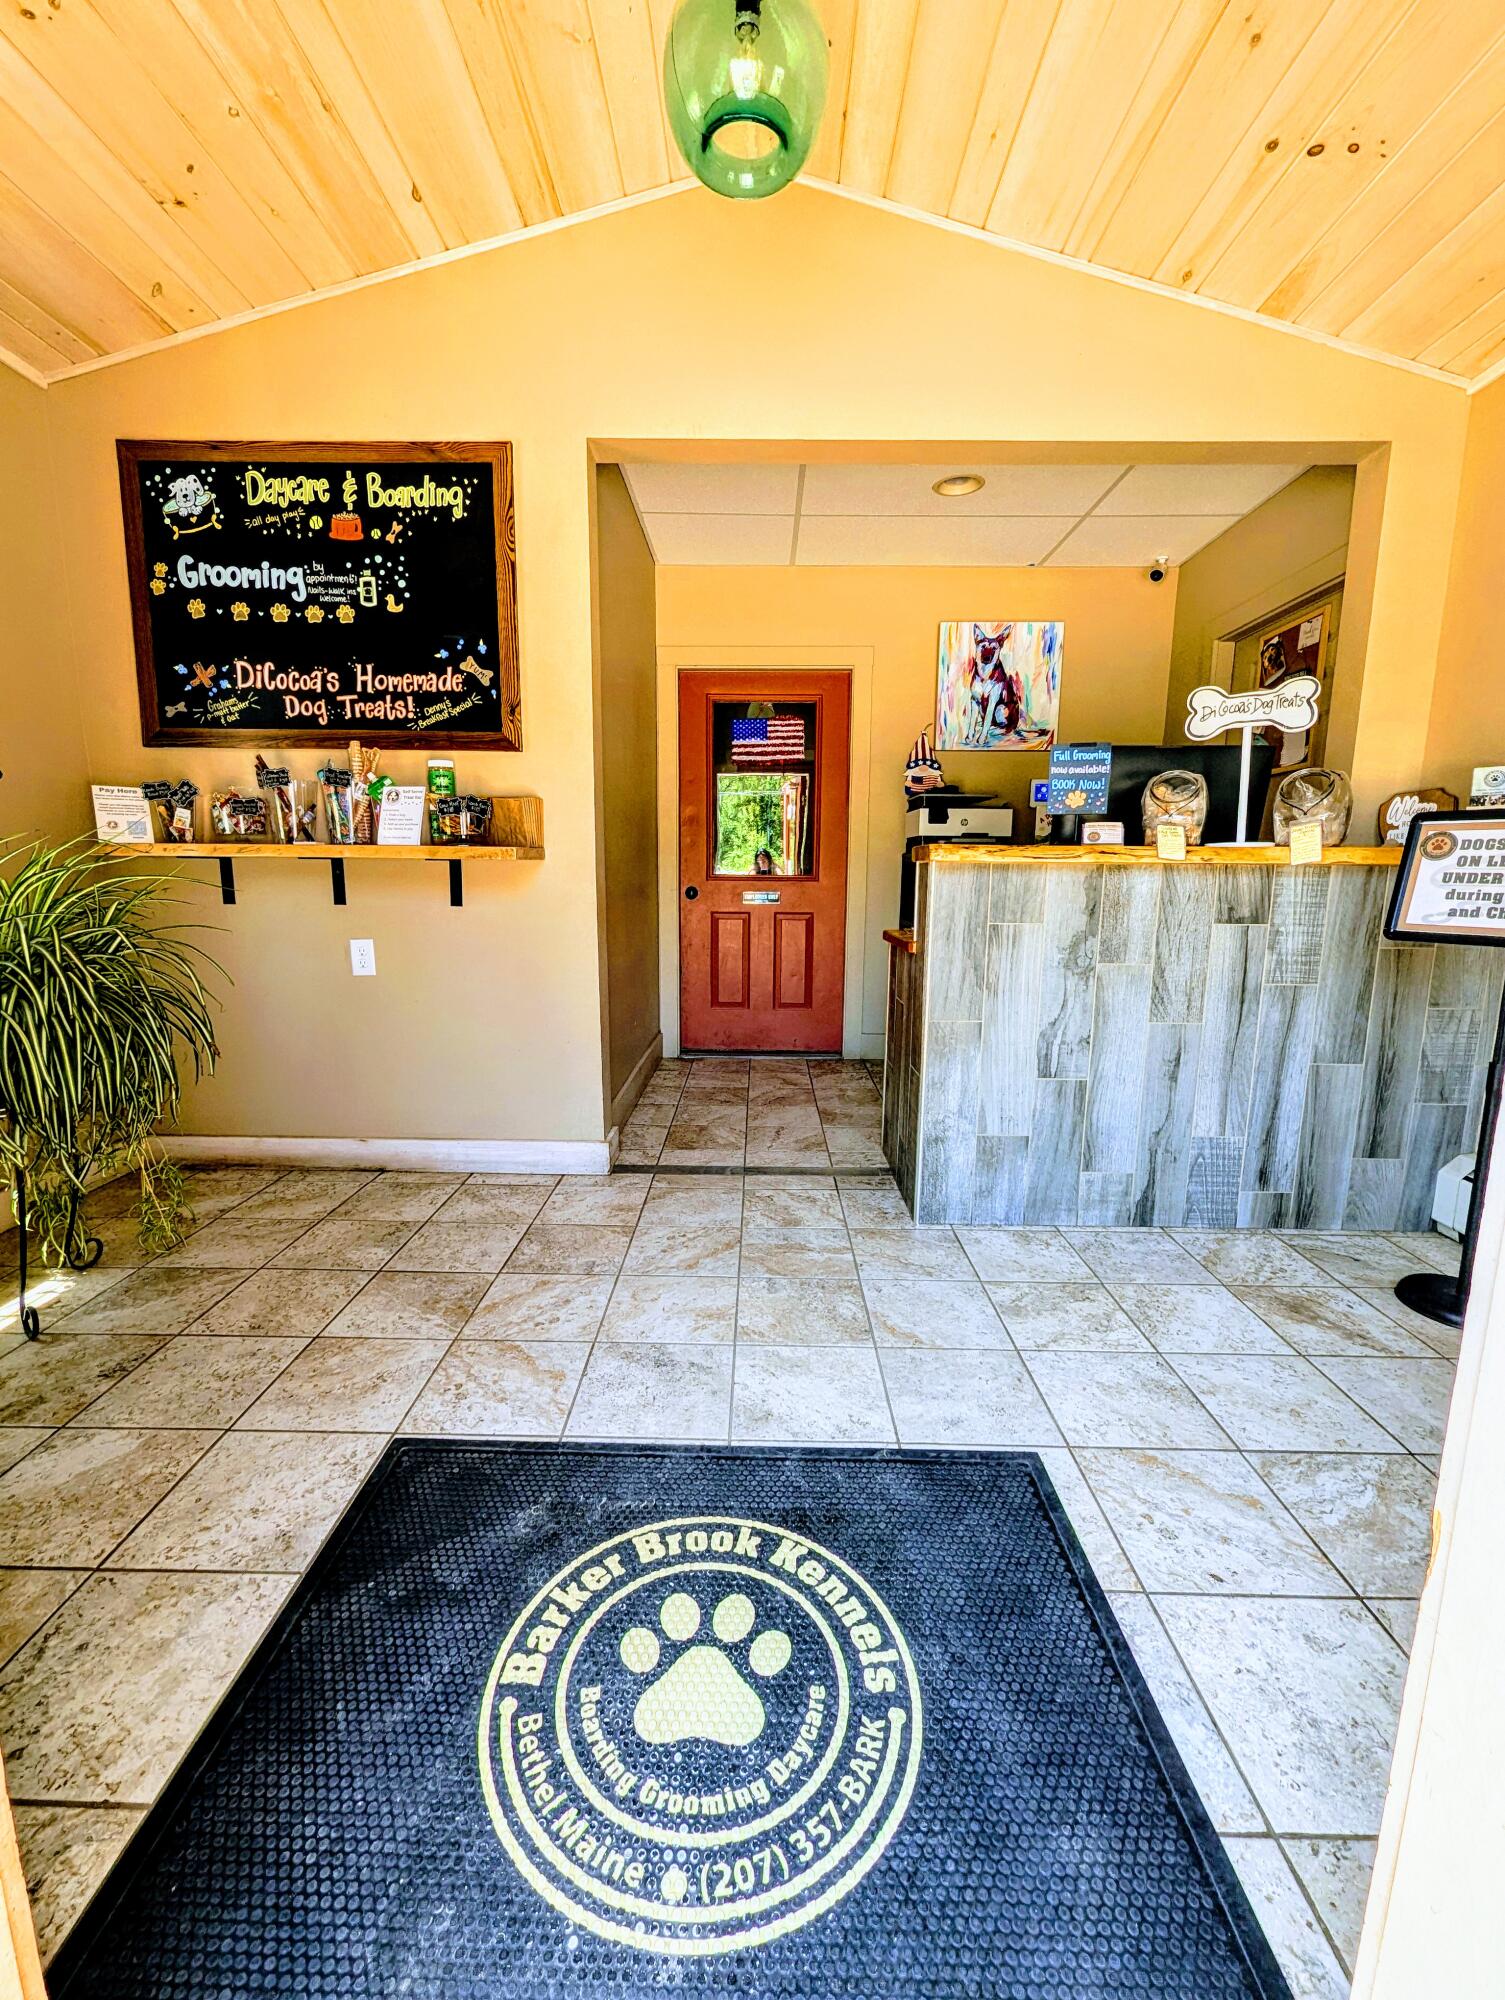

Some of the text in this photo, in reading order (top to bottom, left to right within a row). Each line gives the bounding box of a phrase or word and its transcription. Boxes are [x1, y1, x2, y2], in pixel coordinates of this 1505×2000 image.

[245, 470, 464, 519] Daycare & Boarding
[252, 508, 300, 527] all day play
[313, 560, 324, 575] by
[177, 554, 307, 602] Grooming
[236, 660, 463, 693] DiCocoa's Homemade
[284, 694, 414, 725] Dog Treats!
[448, 697, 473, 716] Special
[1251, 697, 1274, 714] Dog
[1275, 692, 1307, 709] Treats
[1054, 749, 1111, 764] Full Grooming
[1051, 765, 1110, 774] now available!
[1456, 855, 1482, 867] ON
[1442, 872, 1504, 884] UNDER
[1445, 889, 1504, 905] during
[1447, 906, 1481, 918] and
[500, 1527, 900, 1694] Barker Brook Kennels
[580, 1685, 826, 1816] Boarding Grooming Daycare
[517, 1712, 886, 1904] Bethel Maine (207) 357-BARK
